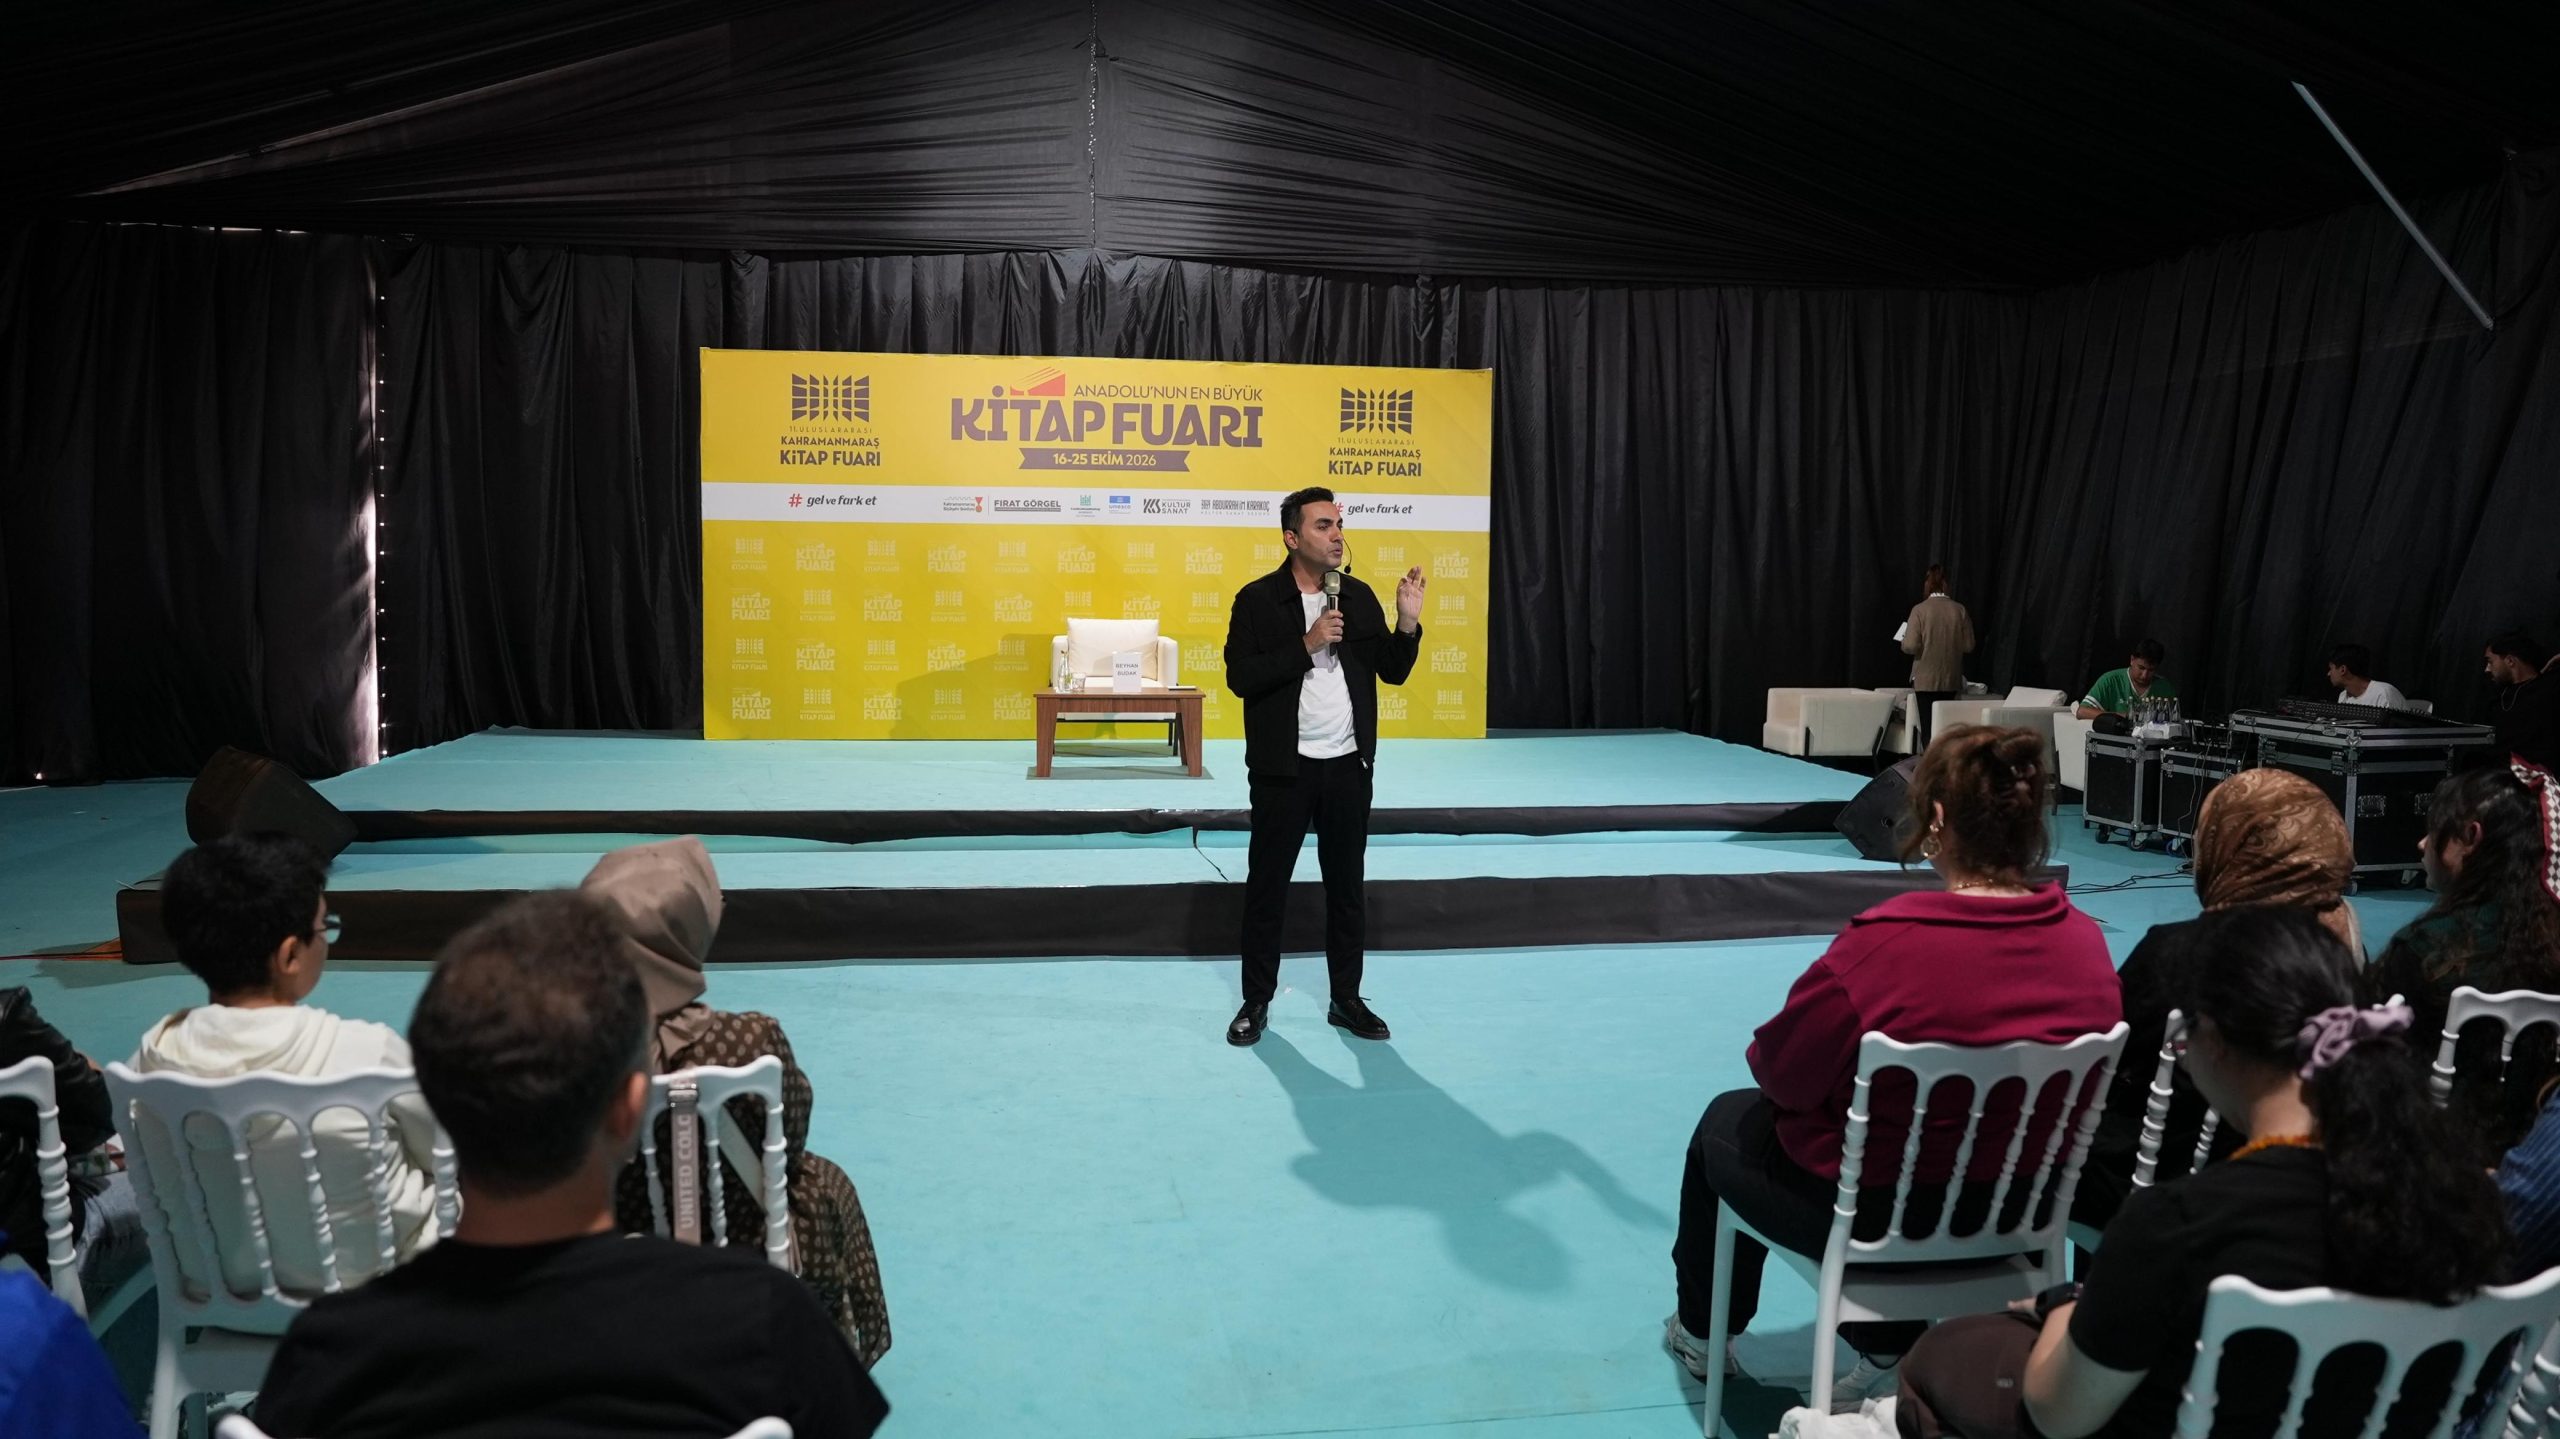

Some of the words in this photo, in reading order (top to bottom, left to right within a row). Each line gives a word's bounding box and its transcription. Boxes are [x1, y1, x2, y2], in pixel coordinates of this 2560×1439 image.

[1073, 384, 1189, 399] ANADOLU'NUN
[1191, 386, 1210, 400] EN
[1213, 384, 1263, 401] BÜYÜK
[951, 385, 1106, 443] KİTAP
[1112, 402, 1264, 448] FUARI
[781, 436, 880, 449] KAHRAMANMARAŞ
[832, 450, 881, 466] FUARI
[1052, 453, 1088, 465] 16-25
[1091, 450, 1124, 466] EKİM
[1126, 454, 1157, 466] 2026
[1329, 447, 1421, 460] KAHRAMANMARAŞ
[1377, 461, 1422, 477] FUARI
[806, 495, 825, 508] gel
[826, 497, 837, 505] ve
[837, 495, 863, 506] fark
[865, 496, 877, 506] et
[1023, 499, 1061, 508] GÖRGEL
[1347, 504, 1364, 515] gel
[1376, 504, 1400, 514] fark
[1401, 505, 1413, 514] et
[679, 1165, 695, 1229] UNITED
